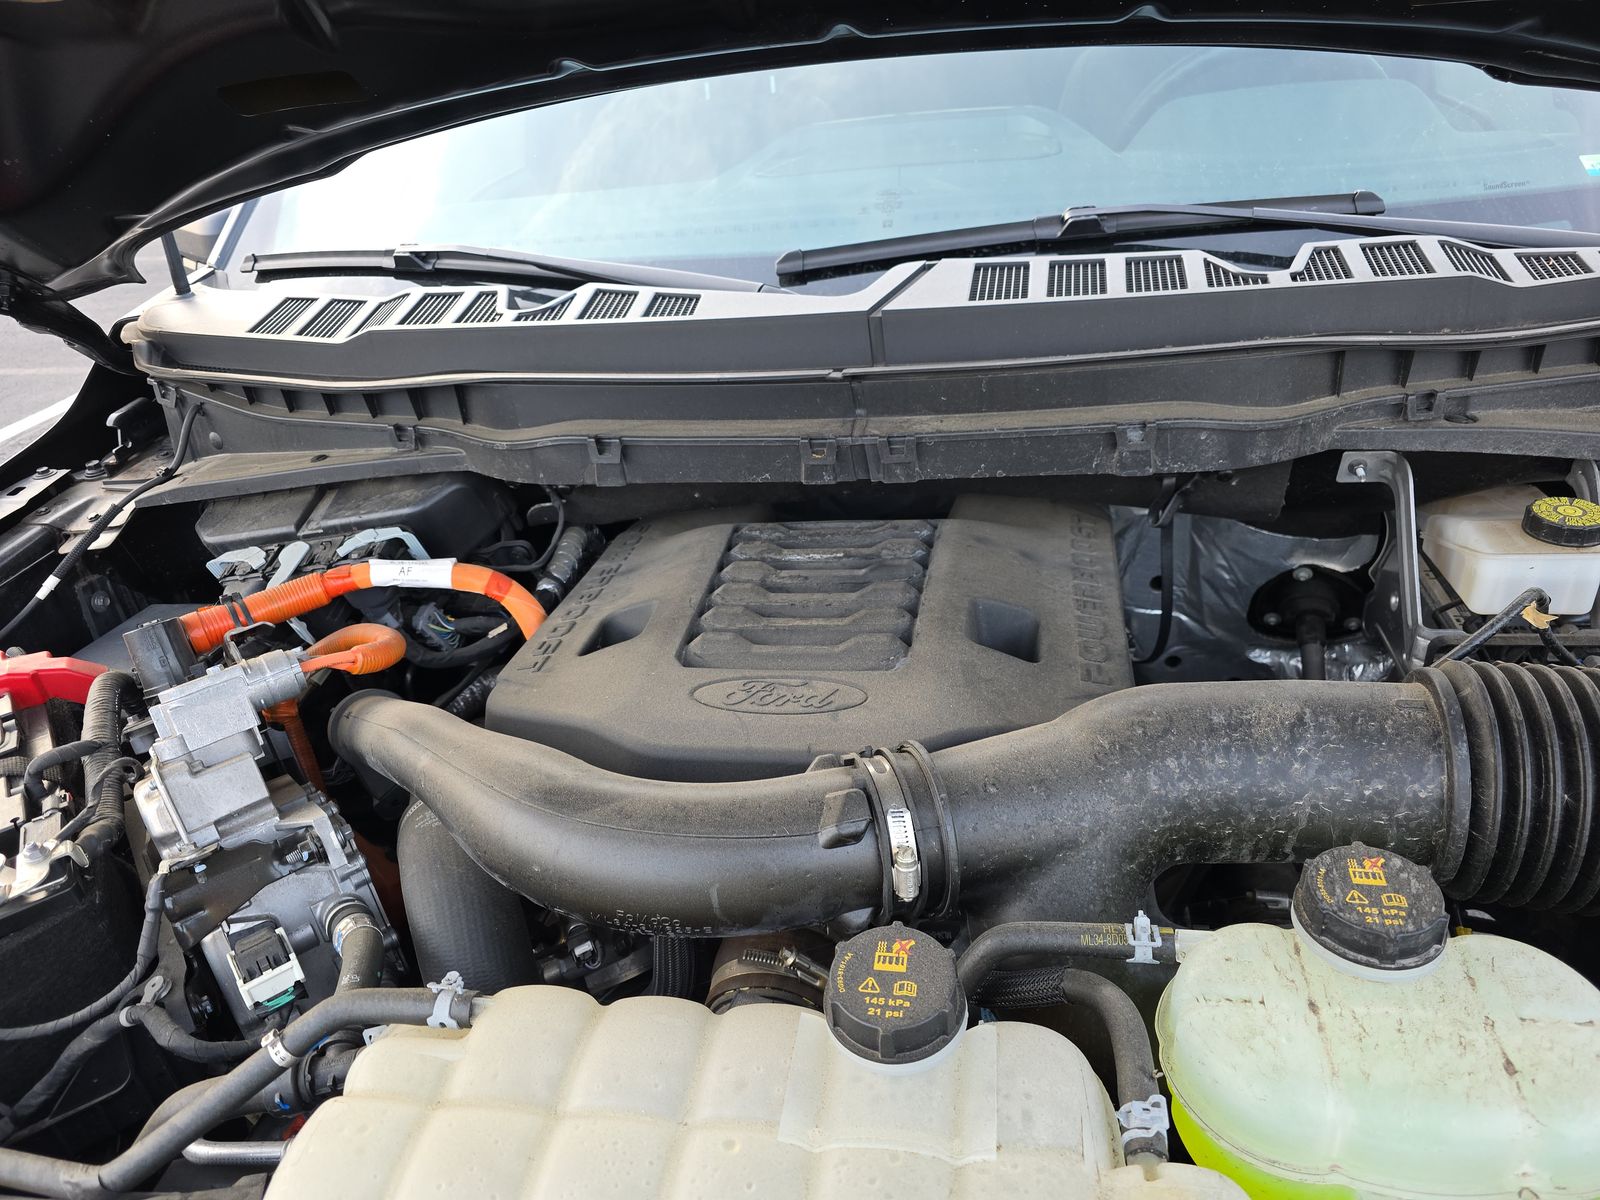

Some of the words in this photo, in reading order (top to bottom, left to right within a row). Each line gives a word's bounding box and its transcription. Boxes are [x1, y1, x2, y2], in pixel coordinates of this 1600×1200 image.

[398, 566, 413, 576] AF
[724, 680, 840, 709] Ford
[1356, 906, 1380, 915] 145
[1382, 908, 1406, 917] kPa
[1365, 916, 1380, 924] 21
[864, 996, 885, 1005] 145
[888, 998, 911, 1008] kPa
[867, 1008, 881, 1016] 21
[886, 1009, 903, 1018] psi
